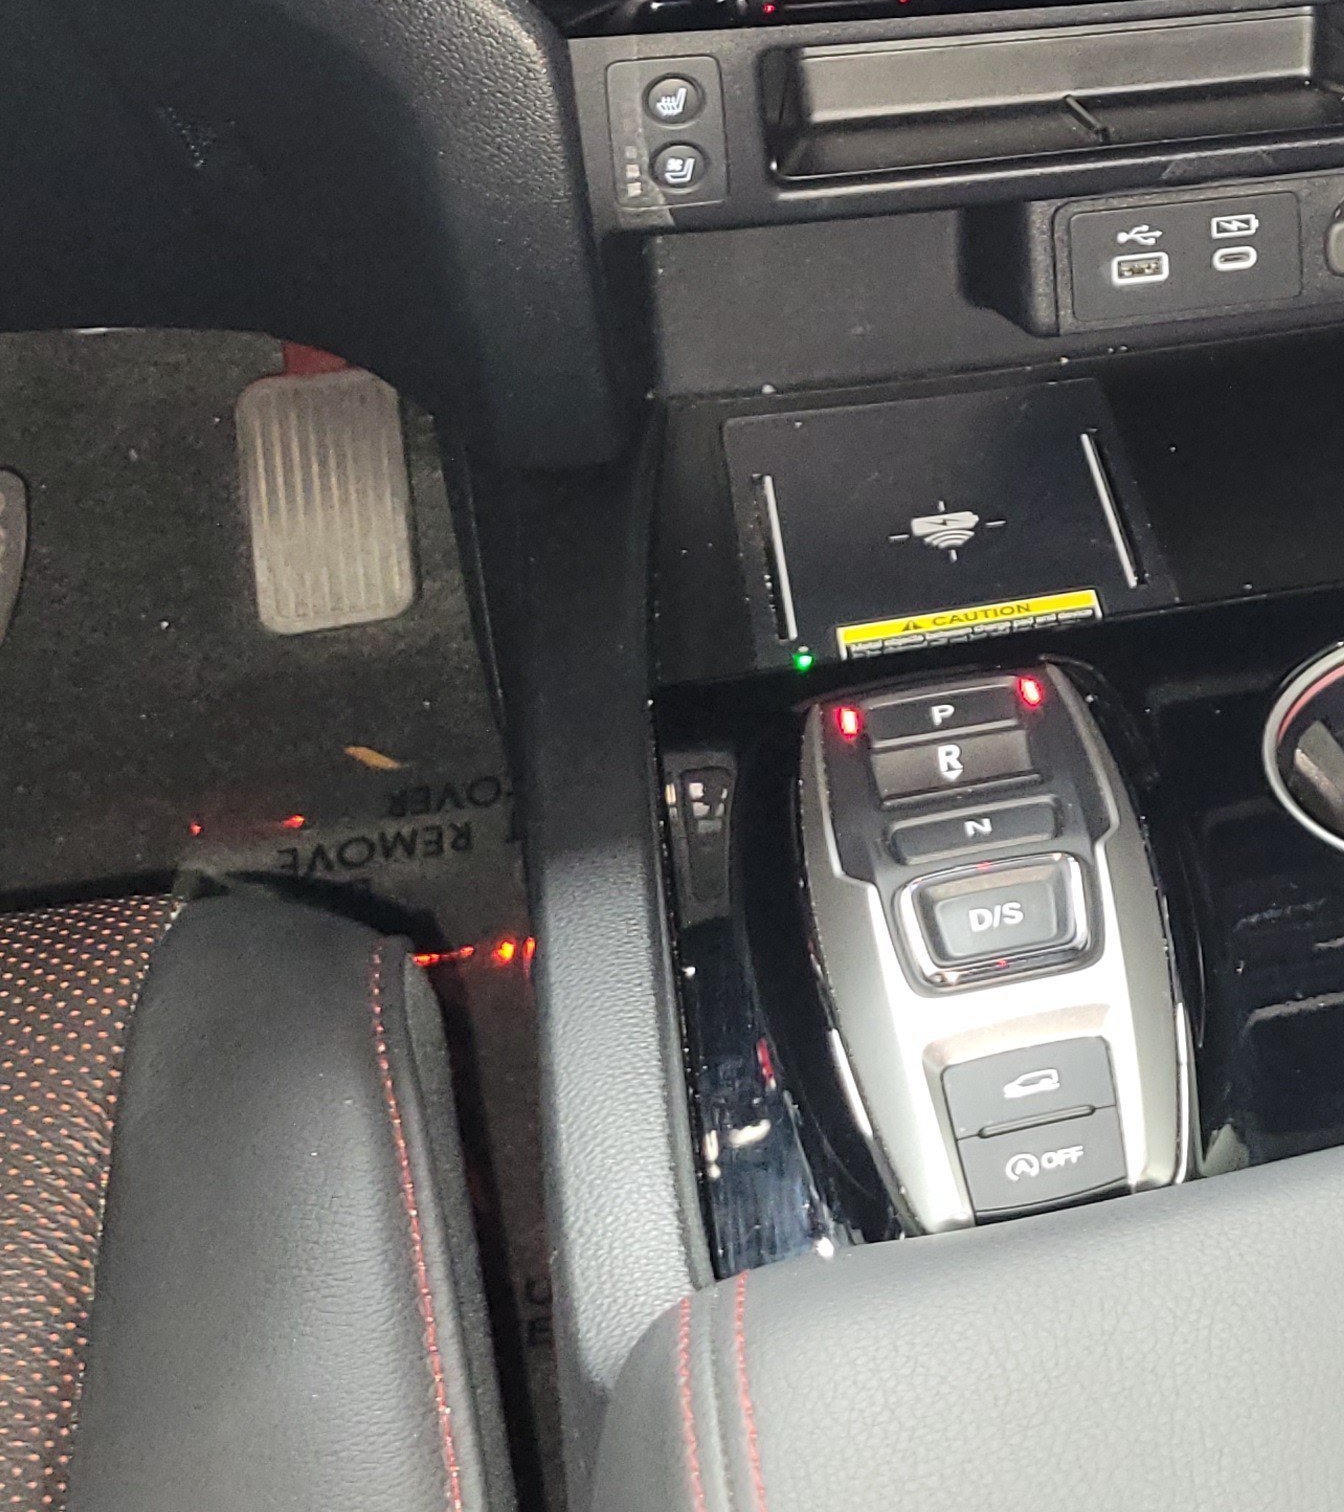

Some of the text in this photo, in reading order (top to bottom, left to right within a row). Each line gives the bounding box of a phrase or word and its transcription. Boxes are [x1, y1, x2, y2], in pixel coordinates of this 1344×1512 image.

[932, 603, 1031, 626] CAUTION
[932, 704, 955, 726] P
[938, 745, 963, 770] R
[964, 817, 992, 838] N
[277, 821, 474, 874] REMOVE
[969, 901, 1024, 932] D/S
[1042, 1145, 1084, 1169] OFF
